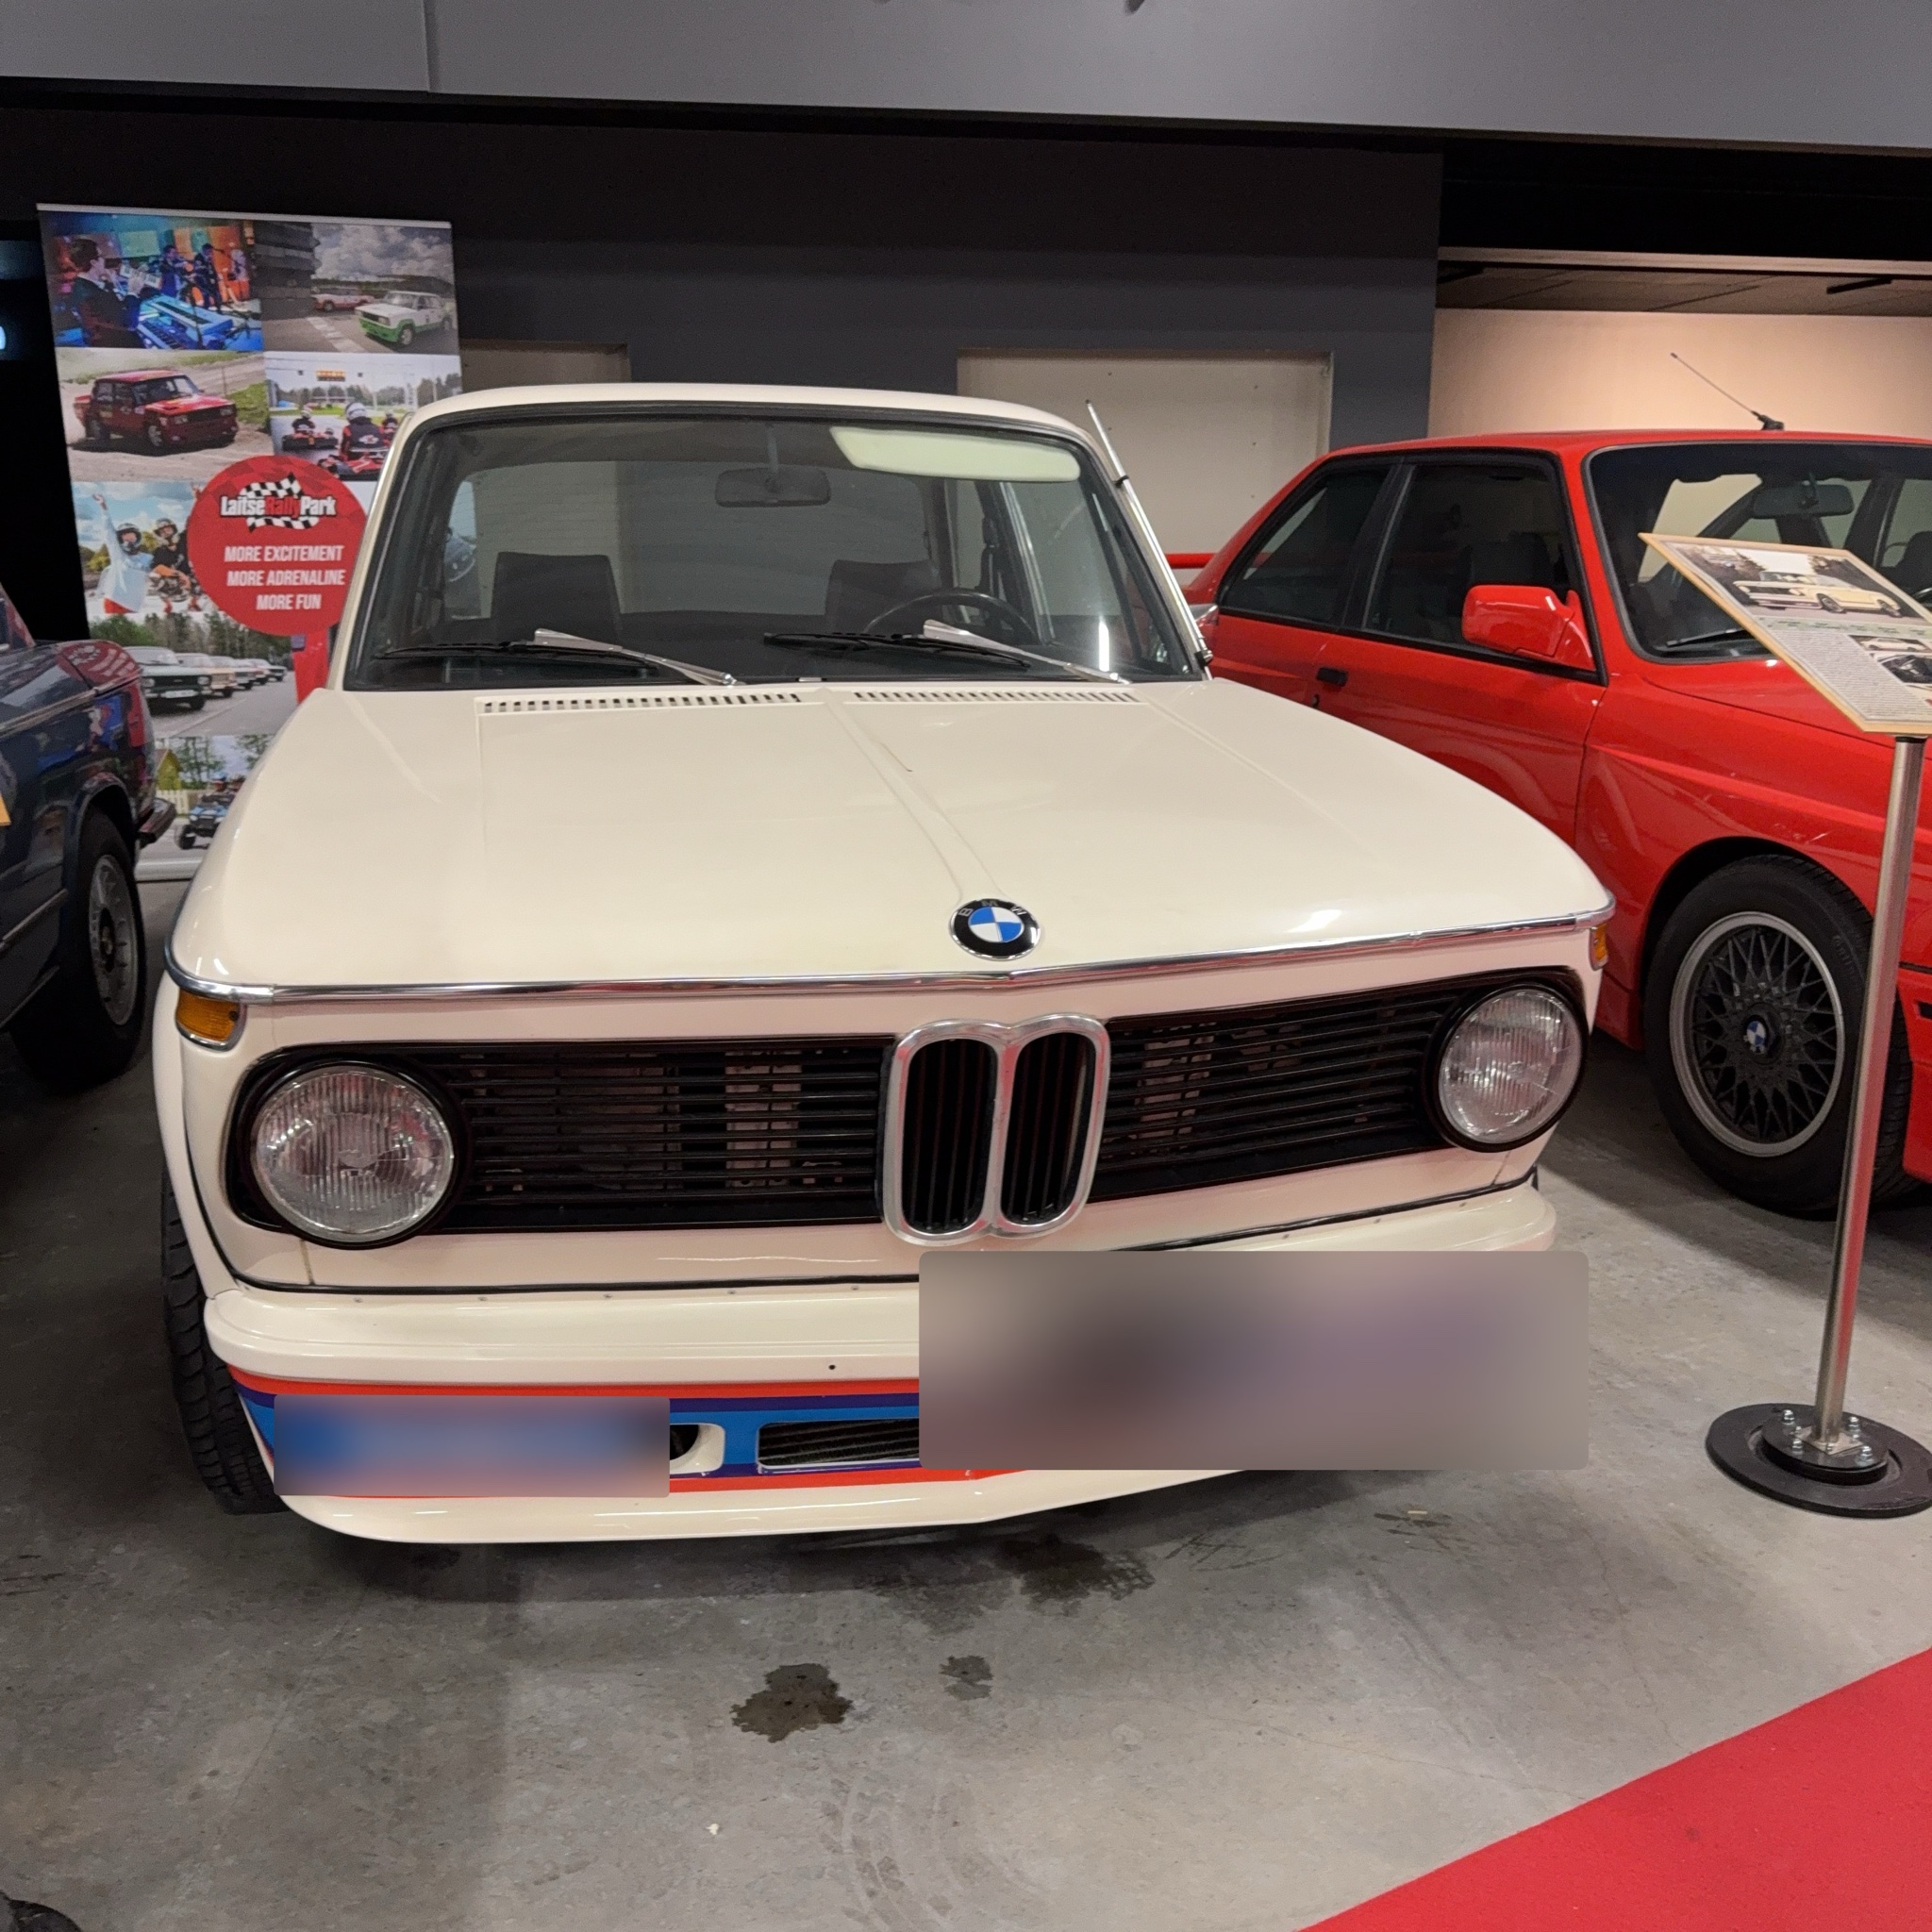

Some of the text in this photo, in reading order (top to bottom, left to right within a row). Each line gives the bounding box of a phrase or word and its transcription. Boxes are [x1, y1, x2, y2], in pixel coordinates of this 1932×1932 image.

[225, 545, 344, 562] MORE EXCITEMENT
[226, 569, 346, 586] MORE ADRENALINE
[256, 593, 322, 610] MORE FUN
